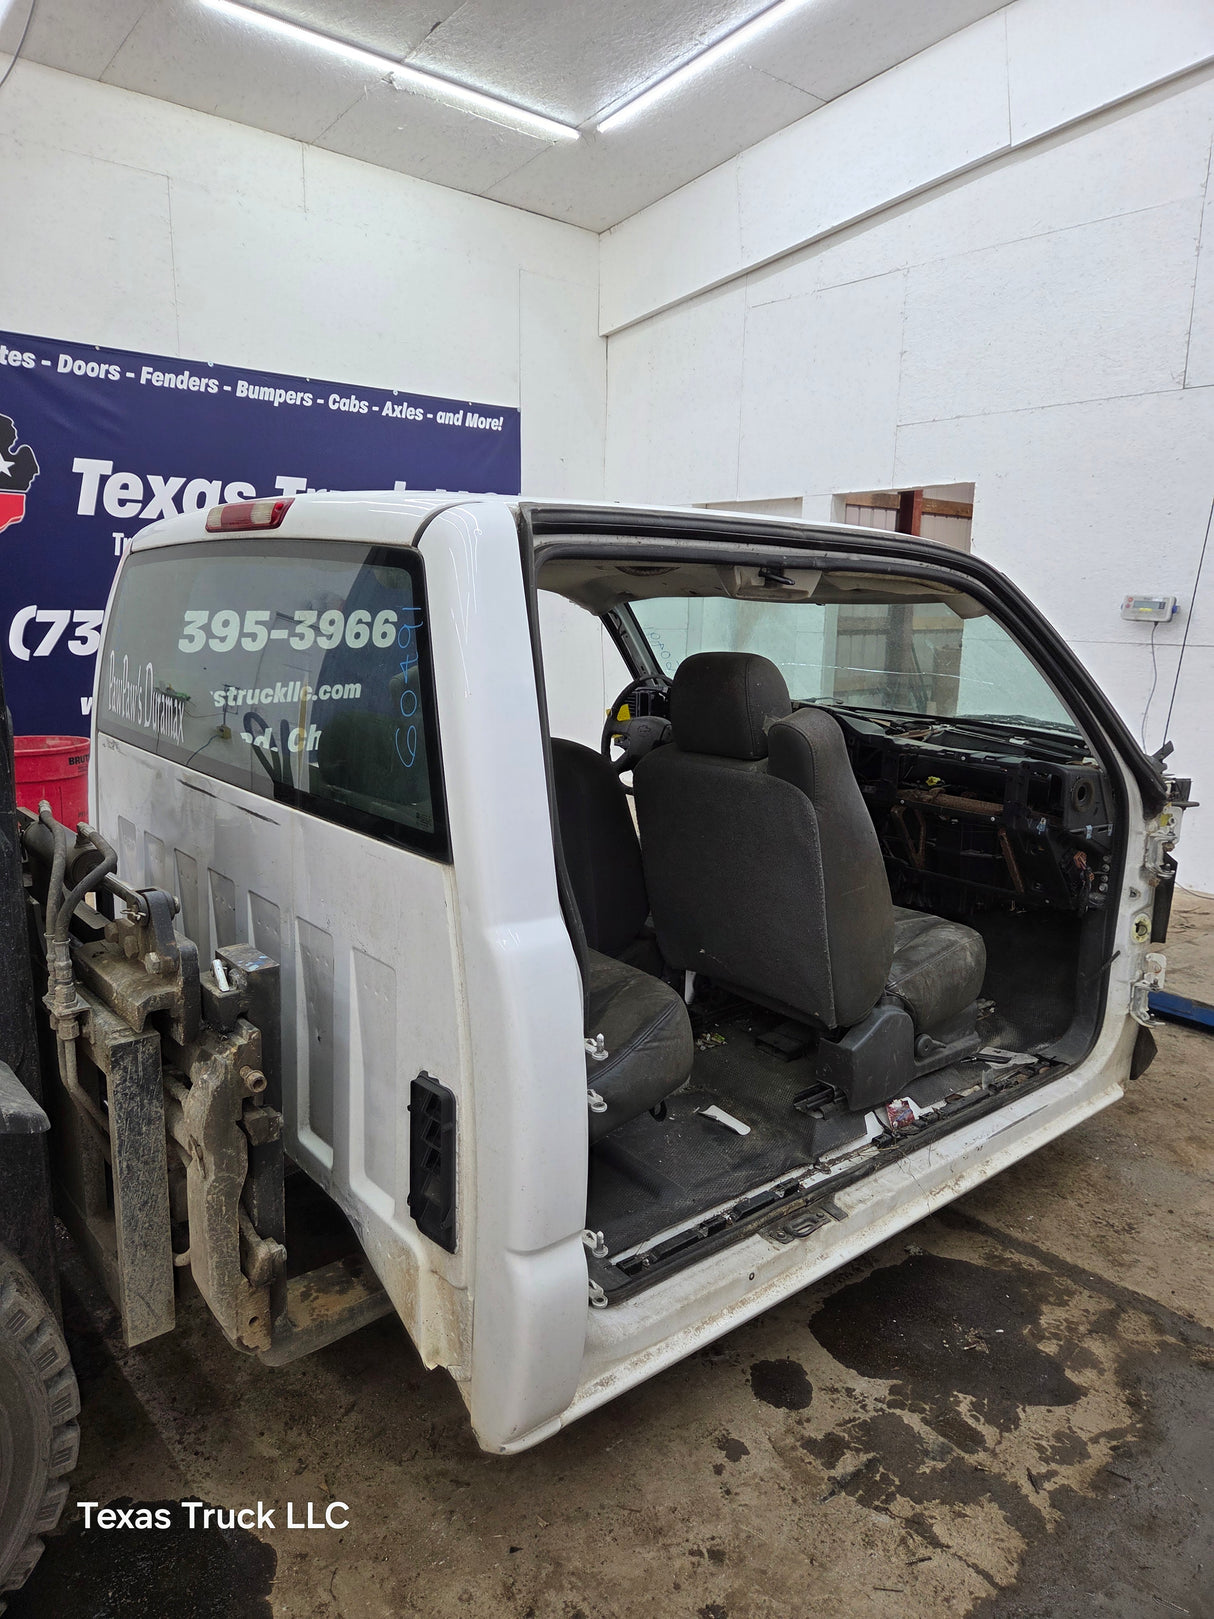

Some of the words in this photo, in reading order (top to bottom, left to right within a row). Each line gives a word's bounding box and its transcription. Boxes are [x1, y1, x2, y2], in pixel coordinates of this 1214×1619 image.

[57, 353, 121, 381] Doors
[140, 366, 219, 394] Fenders
[235, 380, 313, 407] Bumpers
[328, 393, 369, 414] Cabs
[381, 401, 424, 421] Axles
[436, 410, 464, 426] and
[465, 412, 504, 431] More!
[178, 610, 398, 654] 395-3966
[144, 662, 185, 747] Duramax
[210, 680, 362, 707] struckllc.com
[395, 607, 424, 768] 60491
